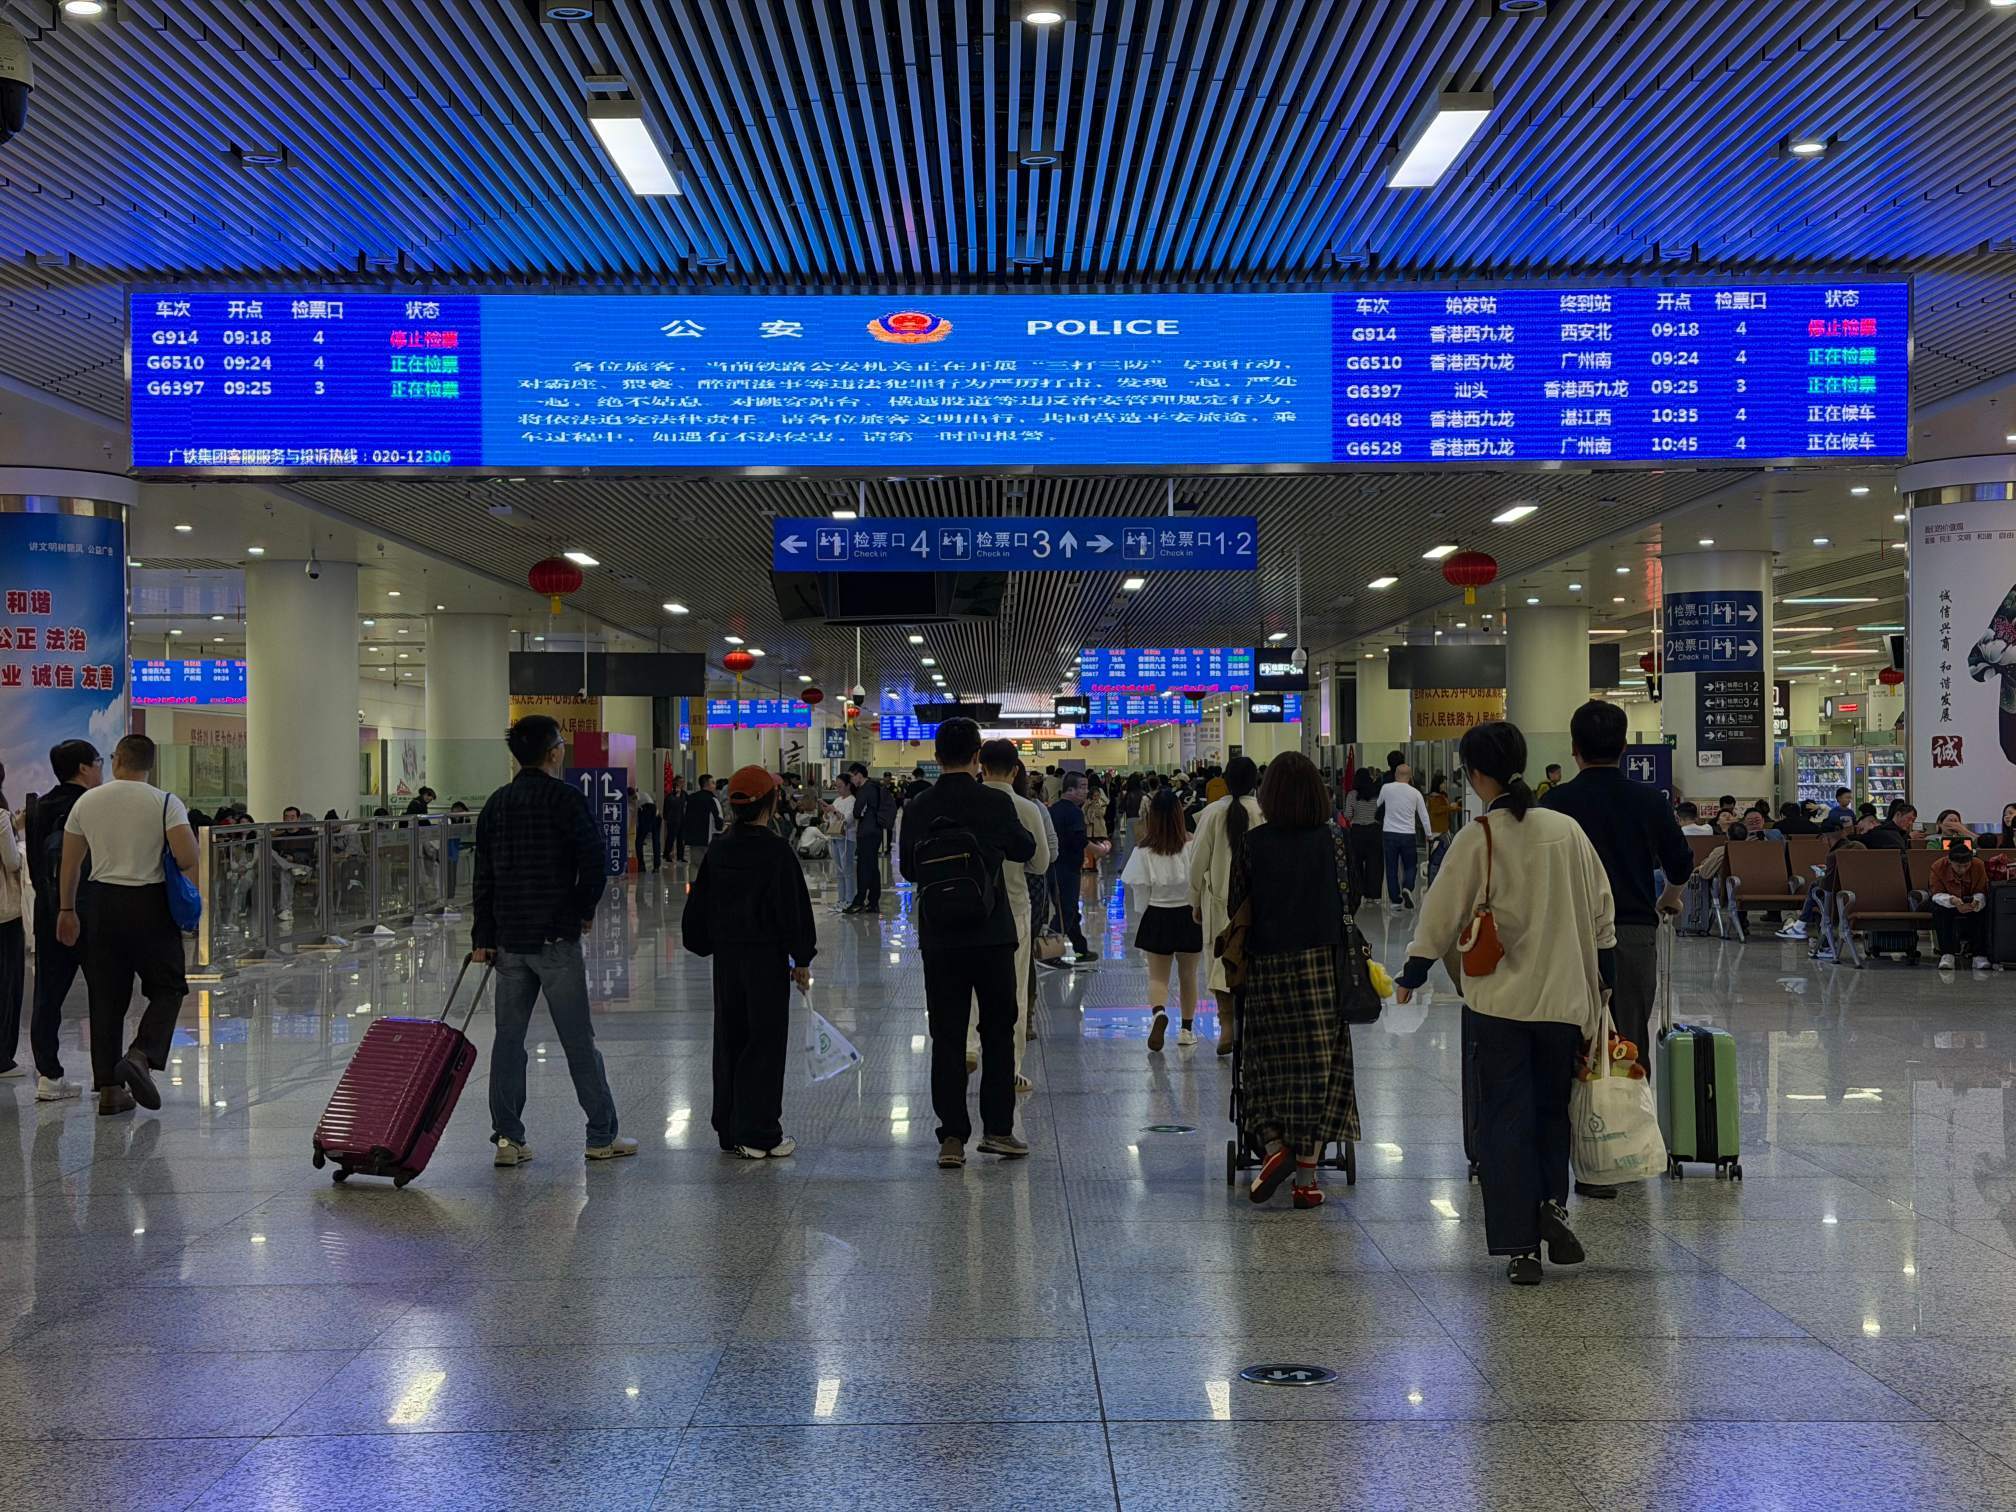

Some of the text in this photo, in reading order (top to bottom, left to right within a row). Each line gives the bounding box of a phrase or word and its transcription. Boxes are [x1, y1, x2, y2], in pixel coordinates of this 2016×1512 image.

[156, 301, 439, 319] 车次 开点 检票口 状态
[1356, 290, 1859, 315] 车次 始发站 终到站 开点 检票口 状态
[661, 320, 803, 338] 公 安
[1028, 320, 1179, 335] POLICE
[1352, 318, 1877, 342] G914 香港西九龙 西安北 09:18 4 停止检票
[152, 331, 458, 348] G914 09:18 4 停止检票
[147, 355, 458, 373] G6510 09:24 4 正在检票
[1347, 348, 1876, 371] G6510 香港西九龙 广州南 09:24 4 正在检票
[147, 381, 459, 398] G6397 09:25 3 正在检票
[1347, 376, 1876, 398] G6397 汕头 香港西九龙 09:25 3 正在检票
[1347, 405, 1876, 427] G6048 香港西九龙 湛江西 10:35 4 正在候车
[1347, 433, 1875, 456] G6528 香港西九龙 广州南 10:45 4 正在候车
[853, 530, 930, 558] 检票口 4
[976, 530, 1051, 558] 检票口 3
[1160, 530, 1211, 547] 检票口
[853, 550, 887, 558] Check in
[976, 550, 1010, 558] Check in
[1160, 549, 1193, 557] Check in
[7, 590, 51, 614] 和谐
[1667, 603, 1710, 626] 1 检票口
[1677, 618, 1699, 626] Check
[46, 628, 86, 651] 法治
[1666, 638, 1710, 661] 2 检票口
[1677, 653, 1710, 661] Check in
[1939, 589, 1953, 723] 诚信兴商 和谐发展
[33, 664, 74, 688] 诚信
[82, 665, 113, 689] 友善
